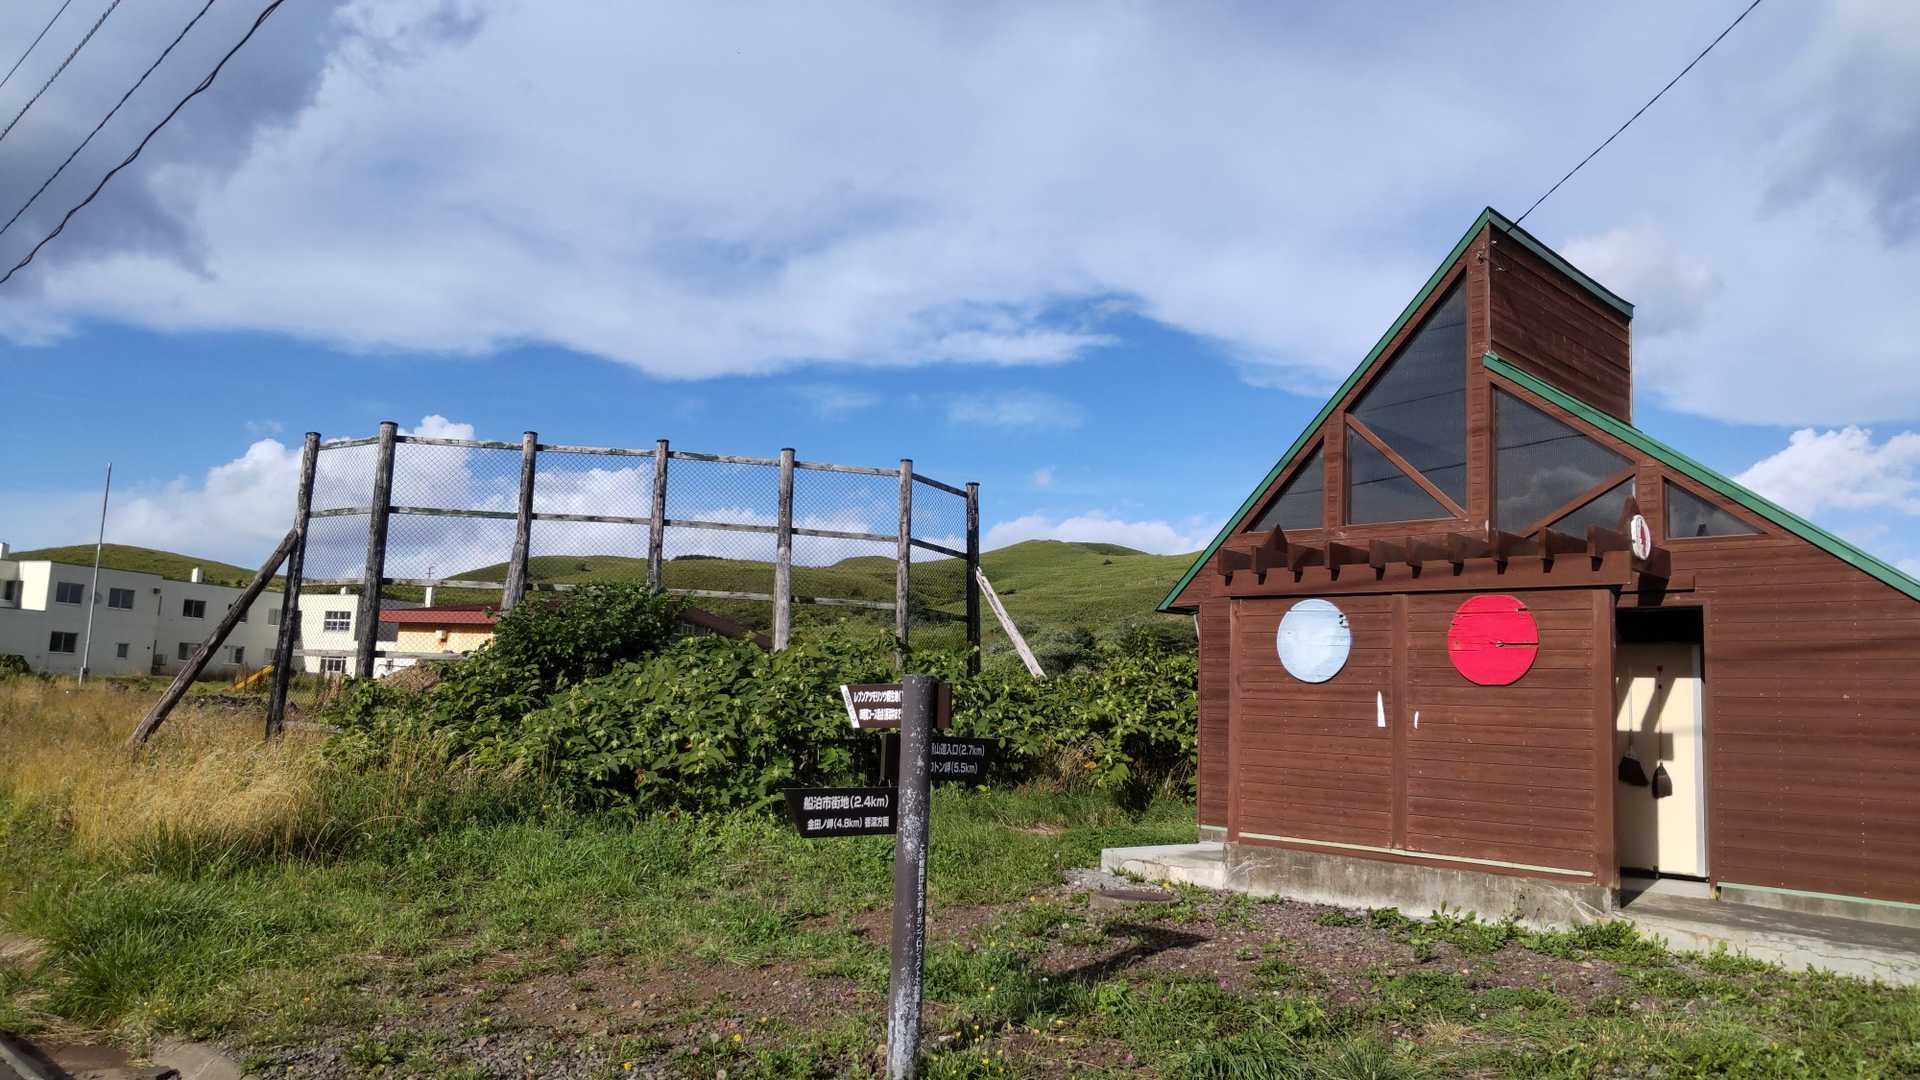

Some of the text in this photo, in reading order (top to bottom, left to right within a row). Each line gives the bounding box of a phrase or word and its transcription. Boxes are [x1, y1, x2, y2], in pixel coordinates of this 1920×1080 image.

[803, 795, 889, 811] 船泊市街地(2.4km)
